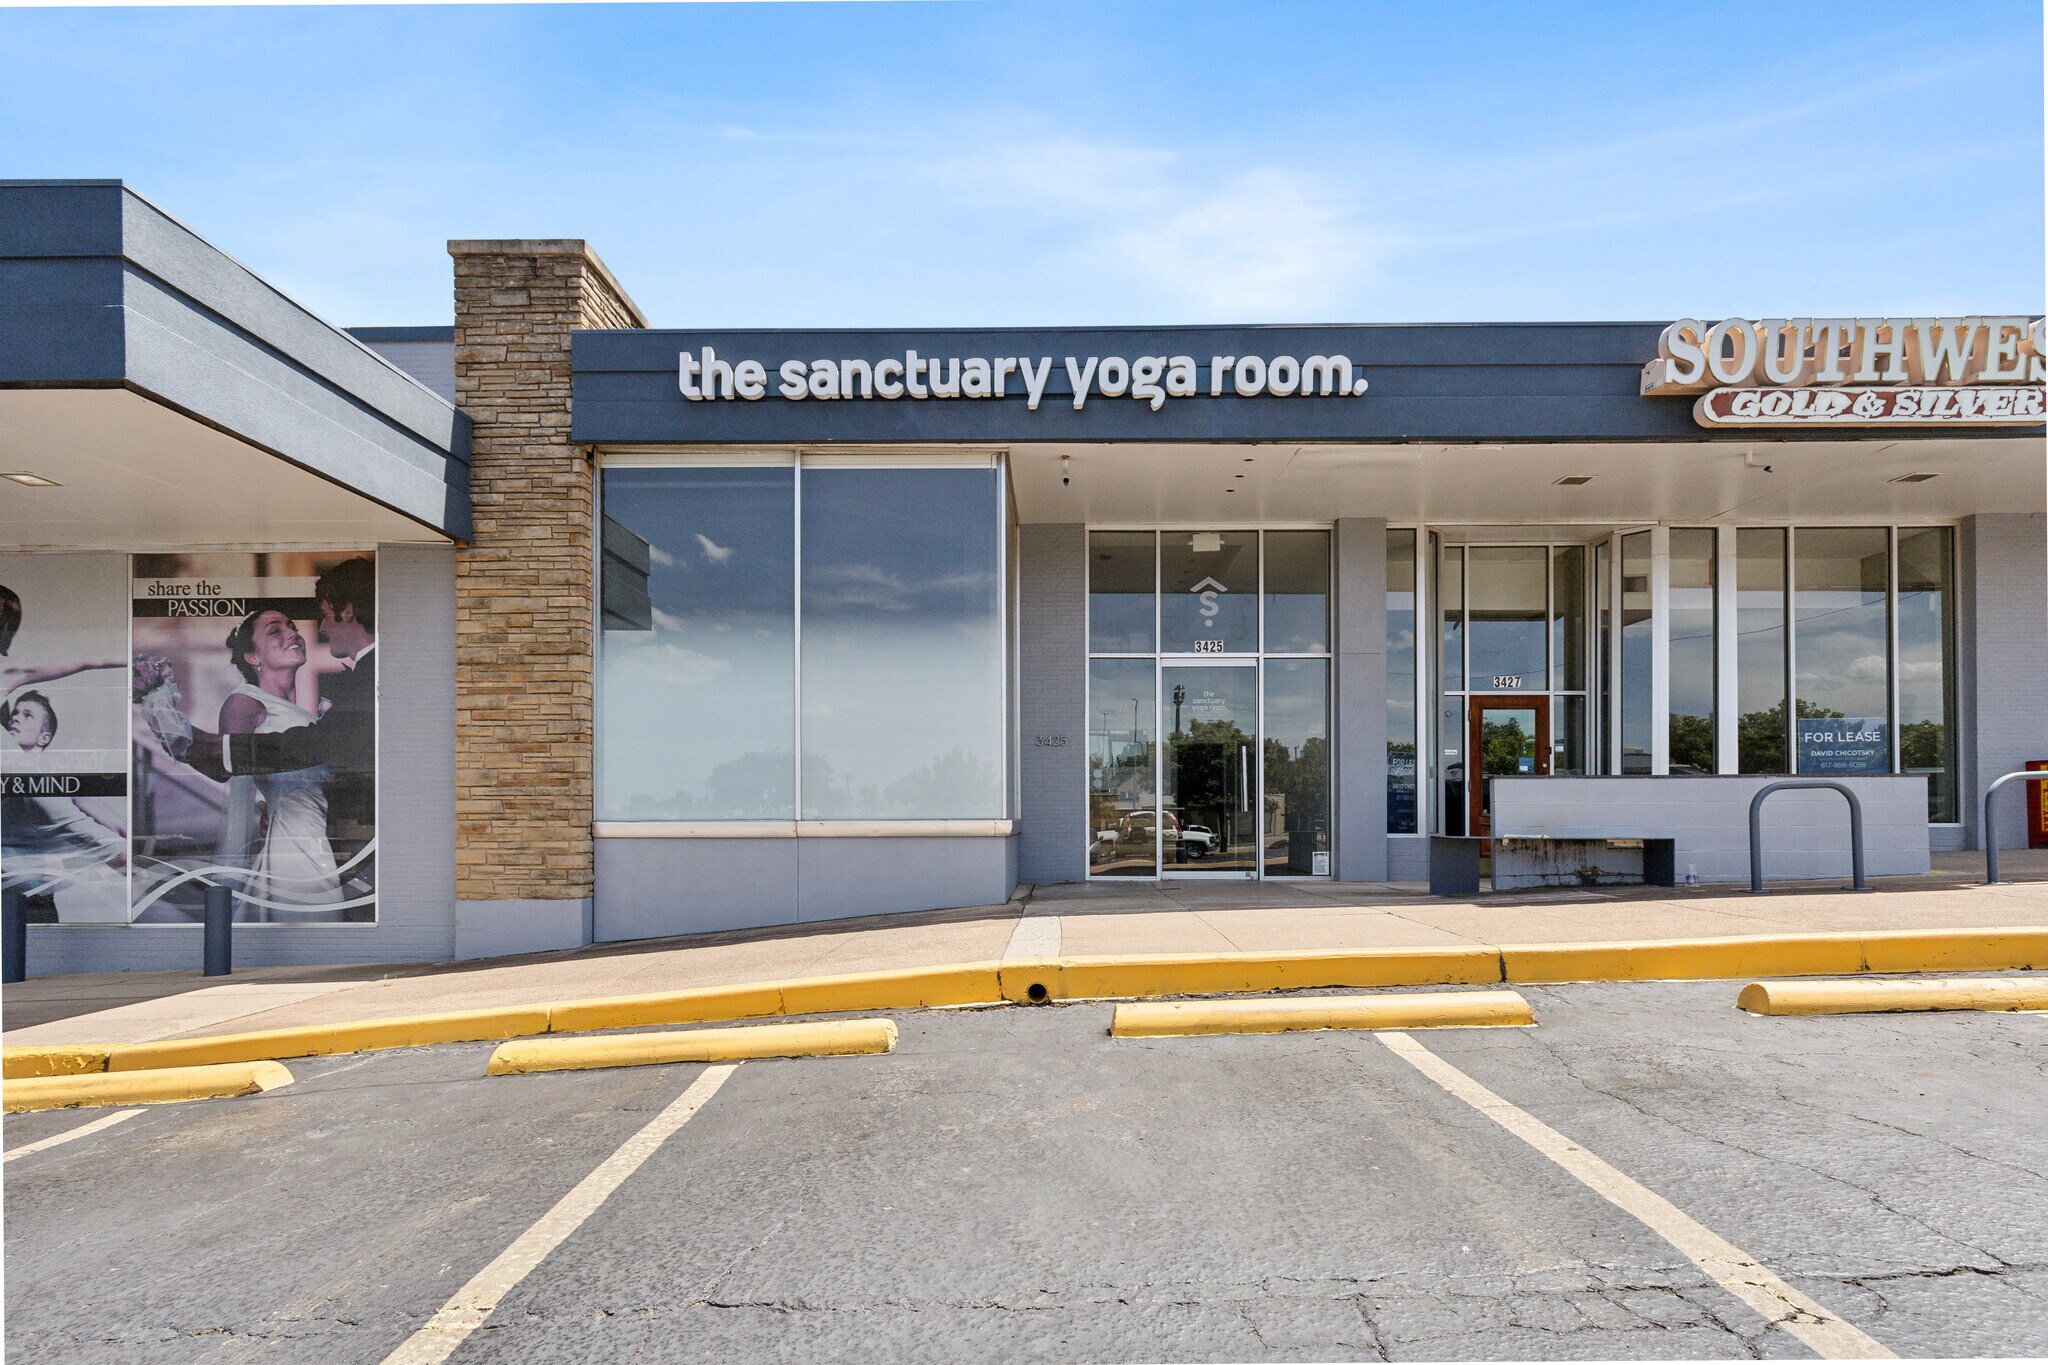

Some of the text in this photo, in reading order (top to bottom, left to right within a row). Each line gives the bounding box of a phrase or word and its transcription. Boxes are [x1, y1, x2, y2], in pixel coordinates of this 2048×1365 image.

[679, 346, 1369, 411] the sanctuary yoga room.
[1729, 389, 2045, 419] GOLD & SILVER
[147, 579, 222, 597] share the
[167, 598, 246, 617] PASSION
[1195, 641, 1223, 653] 3425
[1494, 676, 1521, 688] 3427
[1192, 697, 1226, 705] sanctuary
[1191, 704, 1209, 712] yoga
[1036, 735, 1069, 747] 3425
[1804, 731, 1881, 743] FOR LEASE
[1834, 749, 1876, 757] CHICOTSKY
[1392, 758, 1405, 767] FOR
[12, 776, 26, 794] &
[28, 776, 81, 794] MIND
